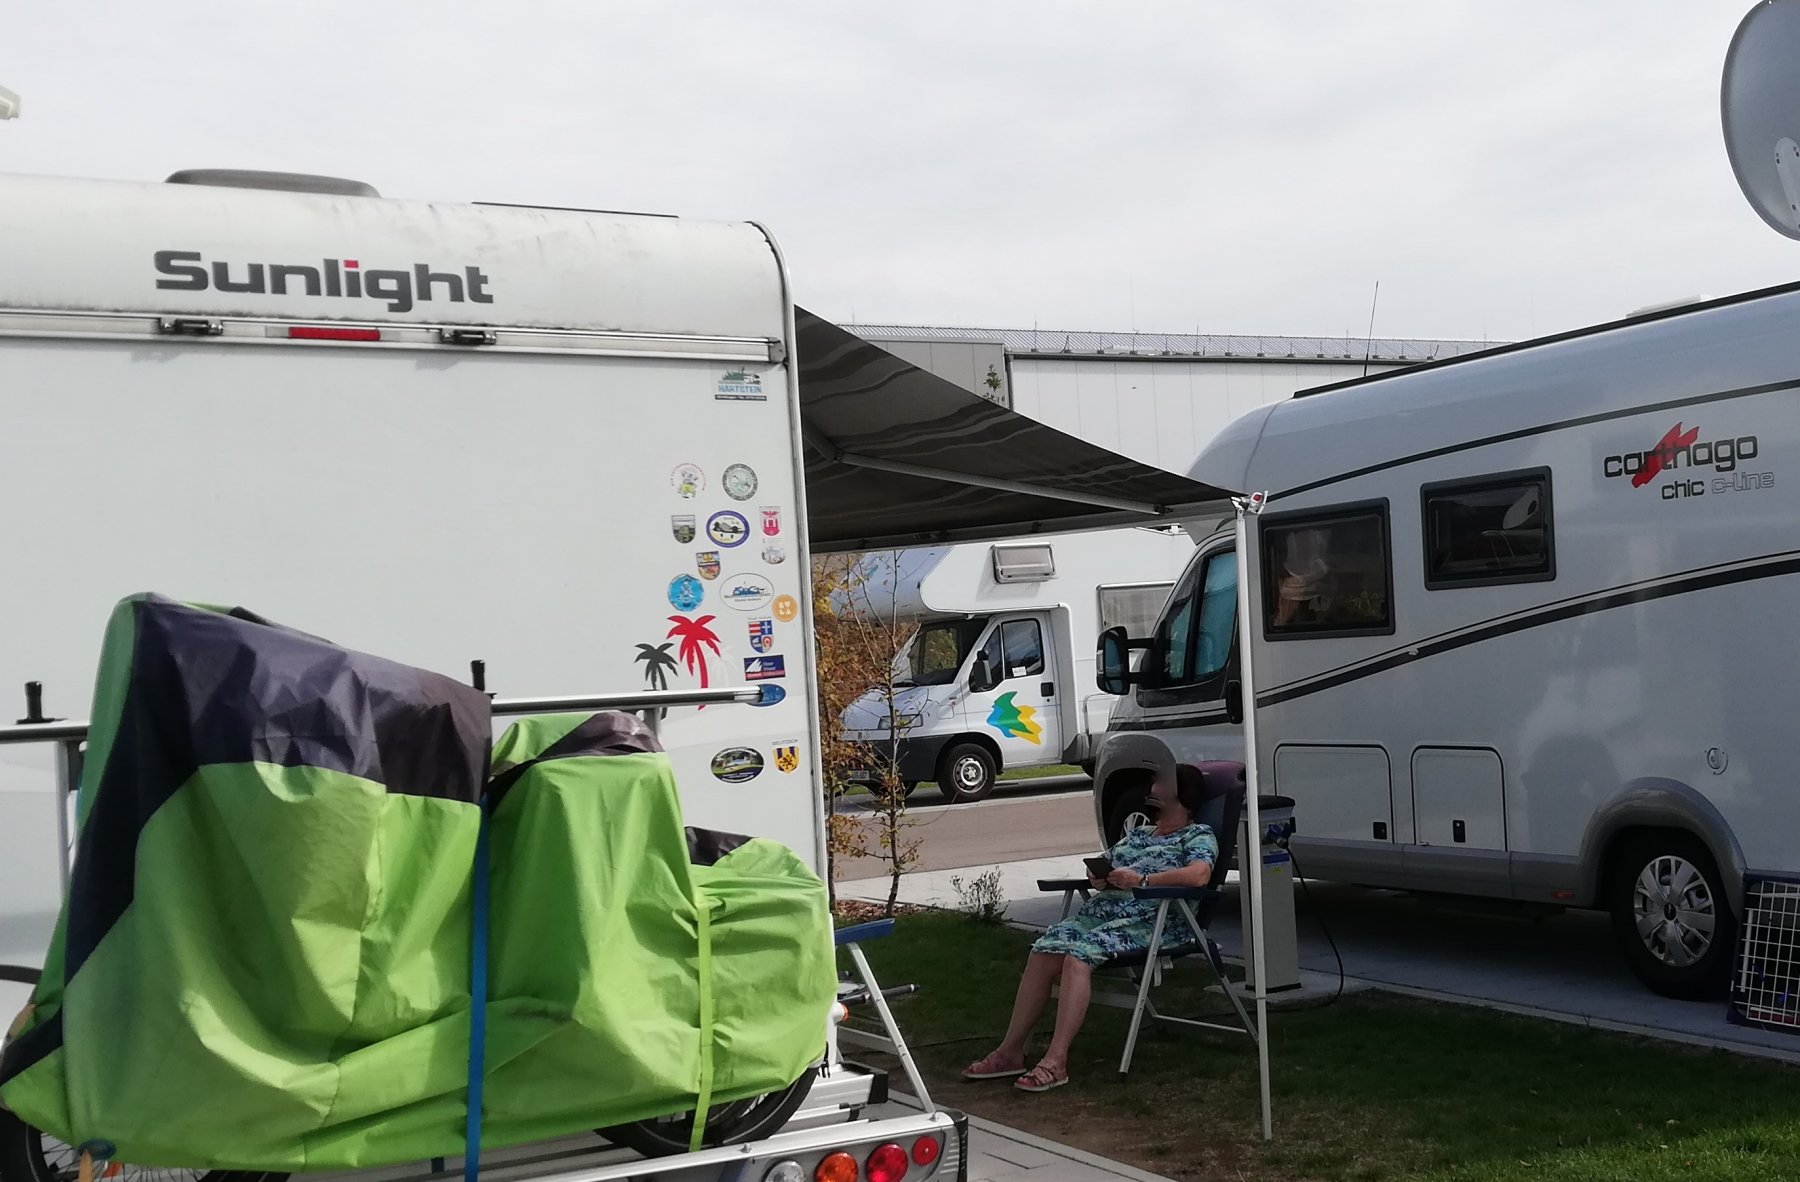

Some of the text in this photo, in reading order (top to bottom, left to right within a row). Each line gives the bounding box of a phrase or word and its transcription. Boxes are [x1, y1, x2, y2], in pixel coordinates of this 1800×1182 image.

[154, 250, 494, 313] Sunlight
[1603, 435, 1759, 478] carthago
[1661, 471, 1775, 500] chic c-line
